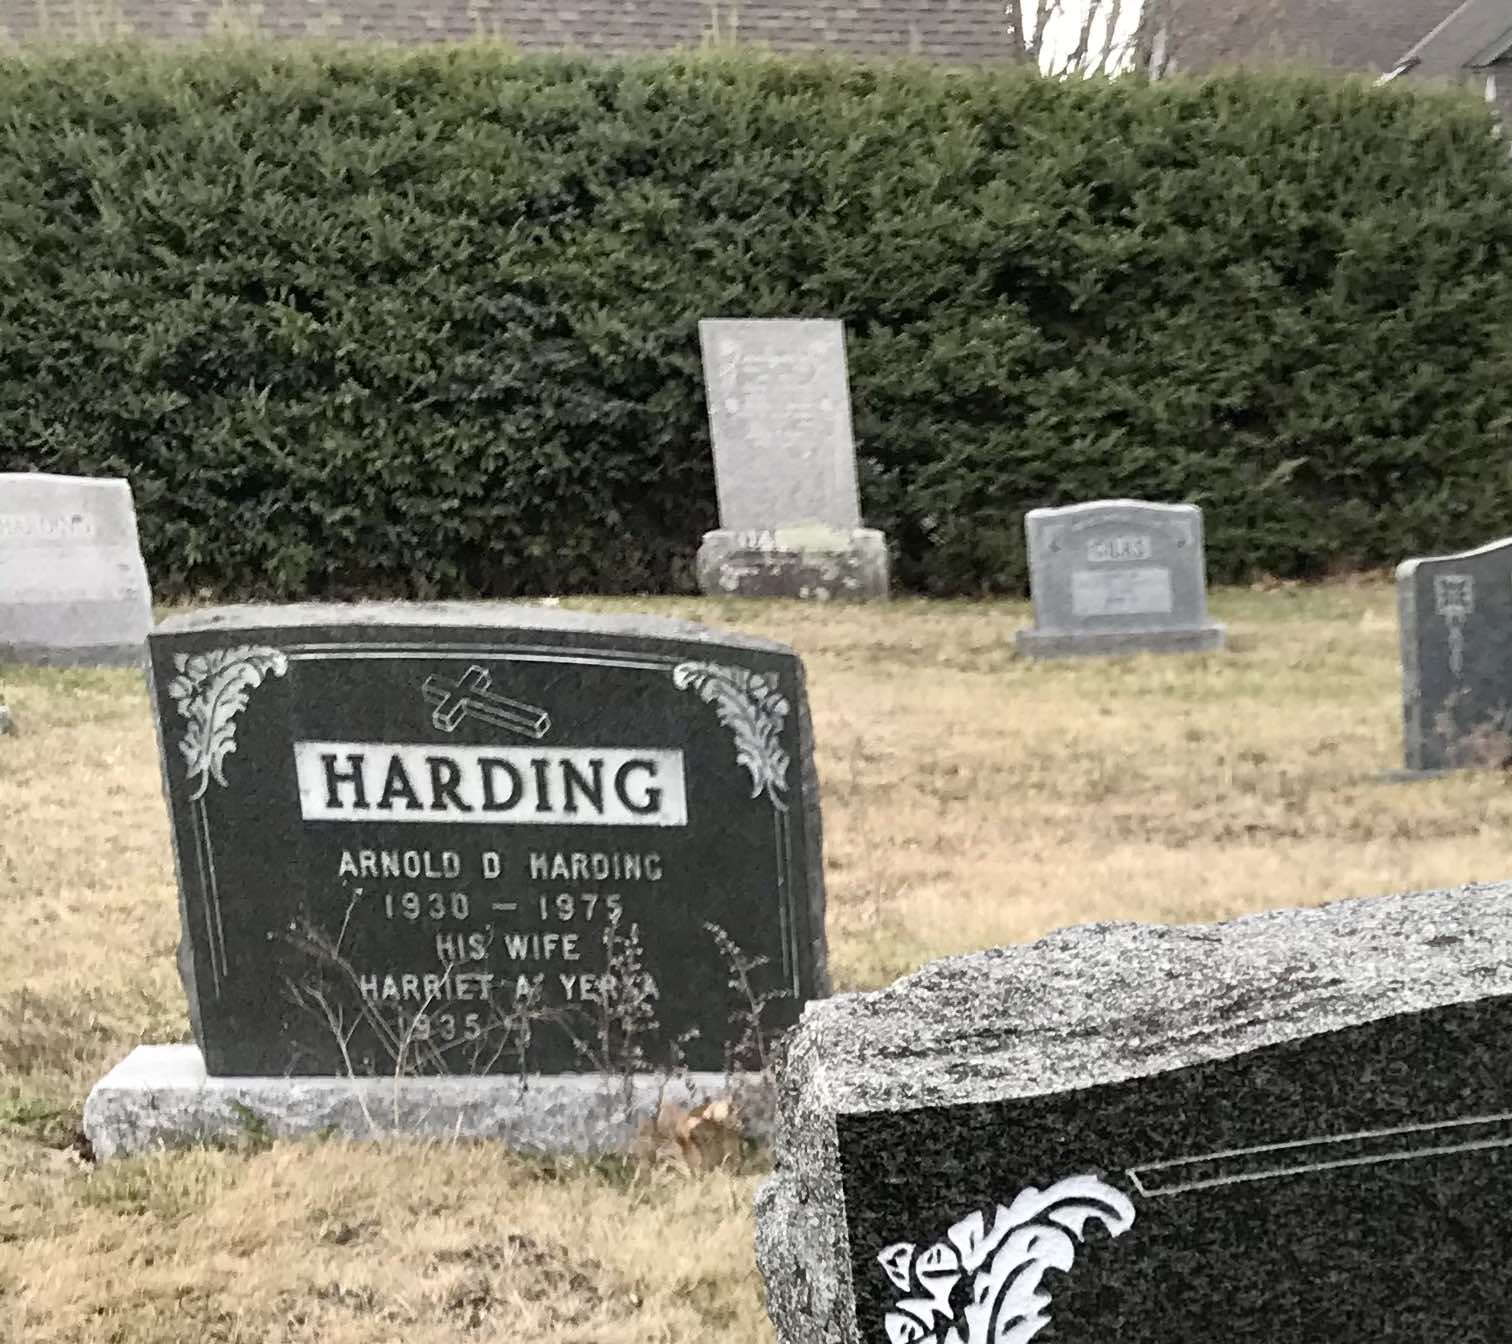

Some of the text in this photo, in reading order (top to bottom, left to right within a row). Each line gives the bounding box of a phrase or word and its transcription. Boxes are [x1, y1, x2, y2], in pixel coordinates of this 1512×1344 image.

[321, 754, 662, 815] HARDING
[338, 850, 663, 881] ARNOLD D HARDING
[385, 893, 469, 920] 1930
[538, 893, 623, 921] 1975
[436, 933, 581, 961] HIS WIFE
[361, 974, 493, 1000] HARRIET
[560, 973, 660, 1000] YERA
